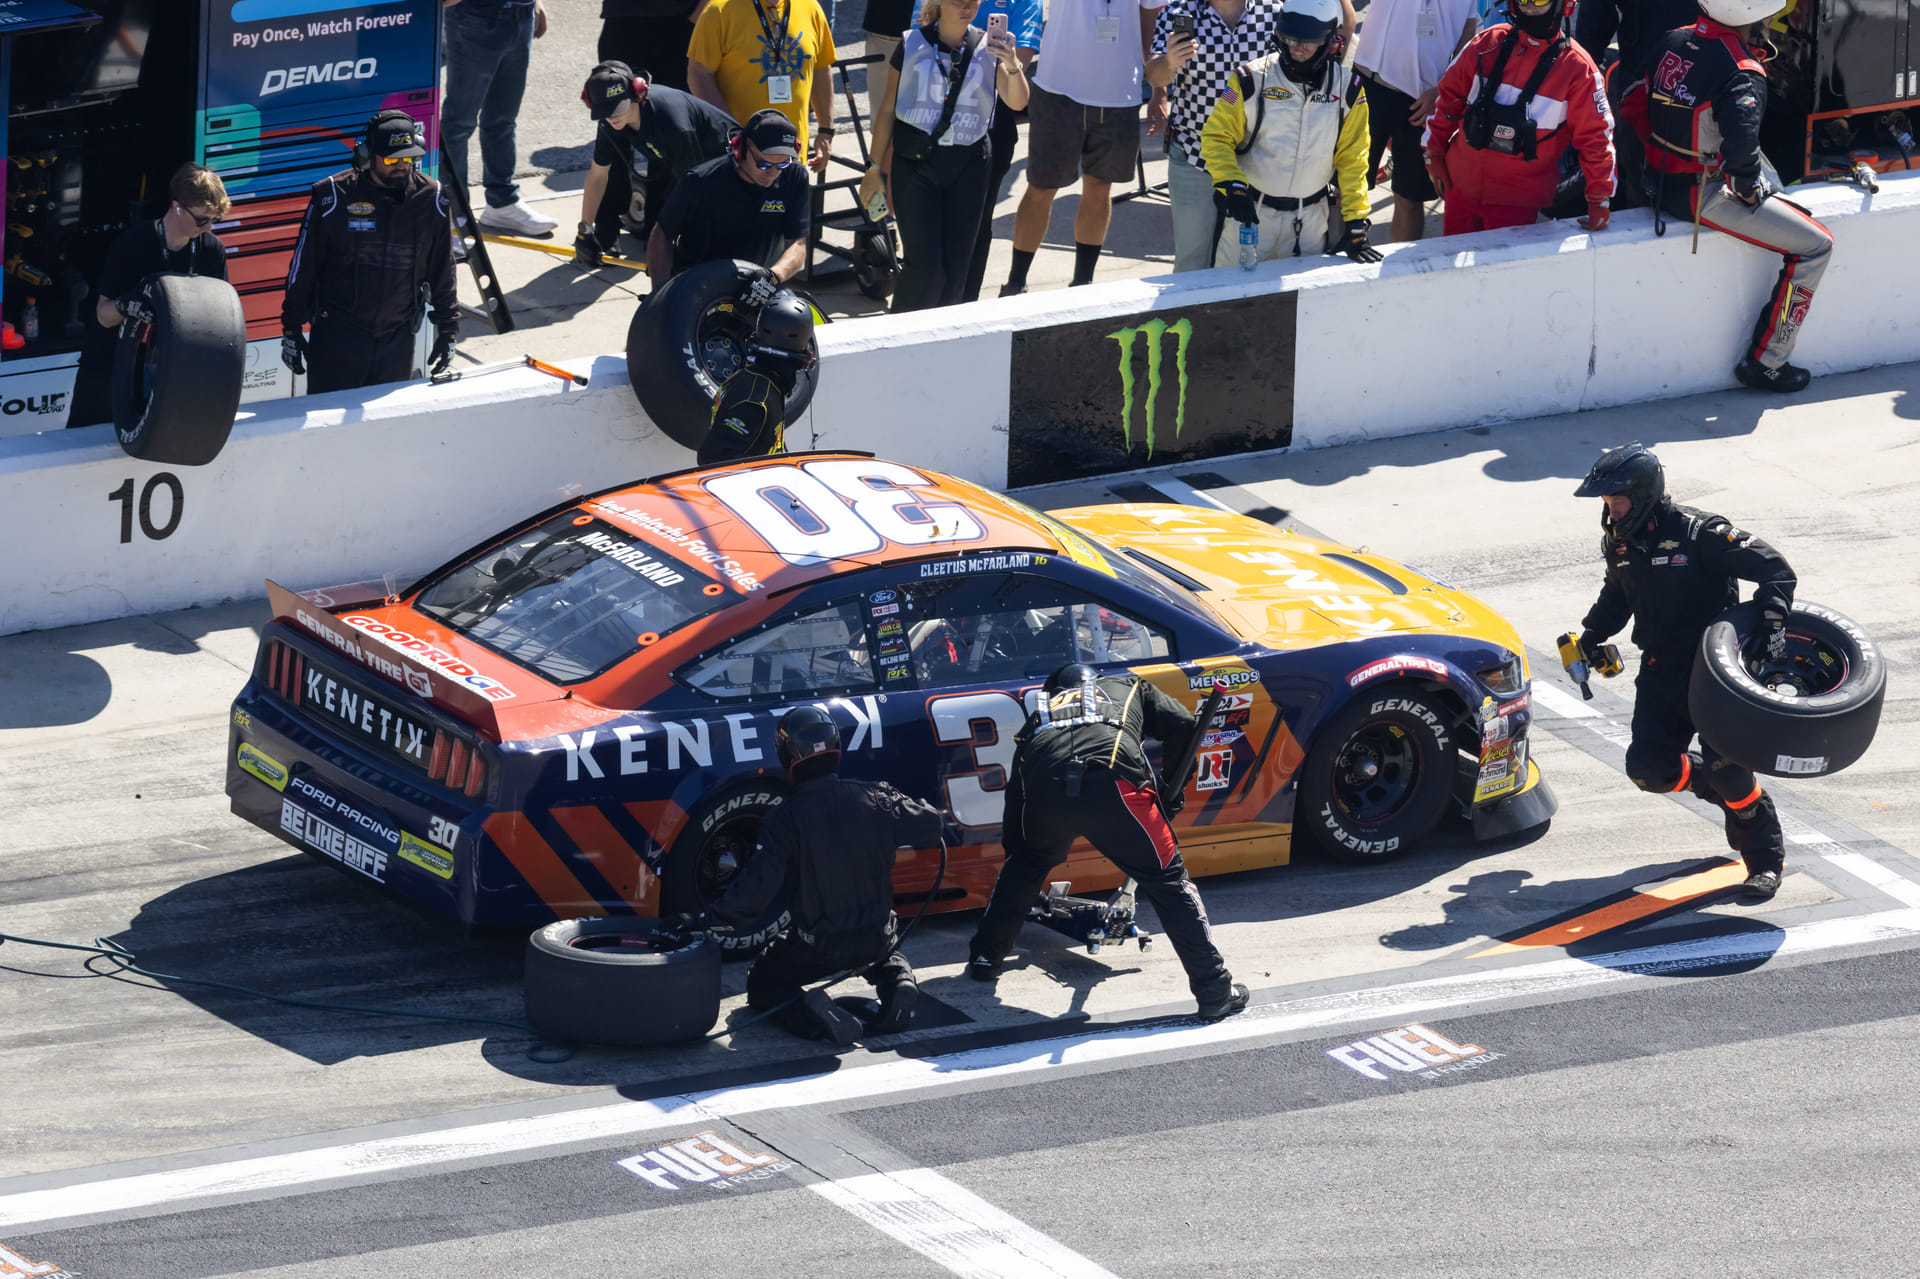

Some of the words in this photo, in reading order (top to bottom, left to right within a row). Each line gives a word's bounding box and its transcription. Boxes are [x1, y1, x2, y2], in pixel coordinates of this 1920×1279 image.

[232, 32, 260, 48] Pay
[262, 28, 304, 43] Once,
[307, 17, 352, 37] Watch
[355, 12, 413, 31] Forever
[259, 57, 378, 97] DEMCO
[1311, 94, 1330, 104] ARCA
[923, 109, 980, 129] NACAR
[108, 471, 184, 544] 10
[702, 460, 988, 566] 30
[576, 531, 685, 588] McFARLAND
[589, 500, 625, 519] Joe
[678, 539, 726, 563] Ford
[713, 559, 766, 593] Sales
[920, 559, 966, 577] CLEETUS
[968, 554, 1030, 572] McFARLAND
[1033, 556, 1048, 566] 16
[296, 609, 364, 662] GENERAL
[367, 652, 403, 682] TIRE
[1792, 601, 1875, 661] GENERAL
[348, 616, 513, 700] GOODRIDGE
[1350, 657, 1399, 687] GENERAL
[1400, 656, 1427, 668] TIRE
[557, 694, 884, 782] KENEK
[1370, 698, 1450, 751] GENERAL
[928, 692, 1046, 827] 3
[1197, 780, 1223, 790] shocks
[290, 776, 336, 809] FORD
[337, 801, 400, 844] RACING
[702, 792, 784, 833] GENERA
[1481, 780, 1512, 794] MENARDS
[281, 800, 305, 838] BE
[344, 834, 388, 881] BIFF
[428, 815, 461, 850] 30
[1321, 801, 1400, 854] GENERAL
[1323, 1022, 1486, 1081] FUEL
[1438, 1051, 1507, 1075] FRANZIA
[612, 1132, 774, 1191] FUEL
[709, 1176, 734, 1190] BY
[731, 1158, 799, 1184] FRANZIA
